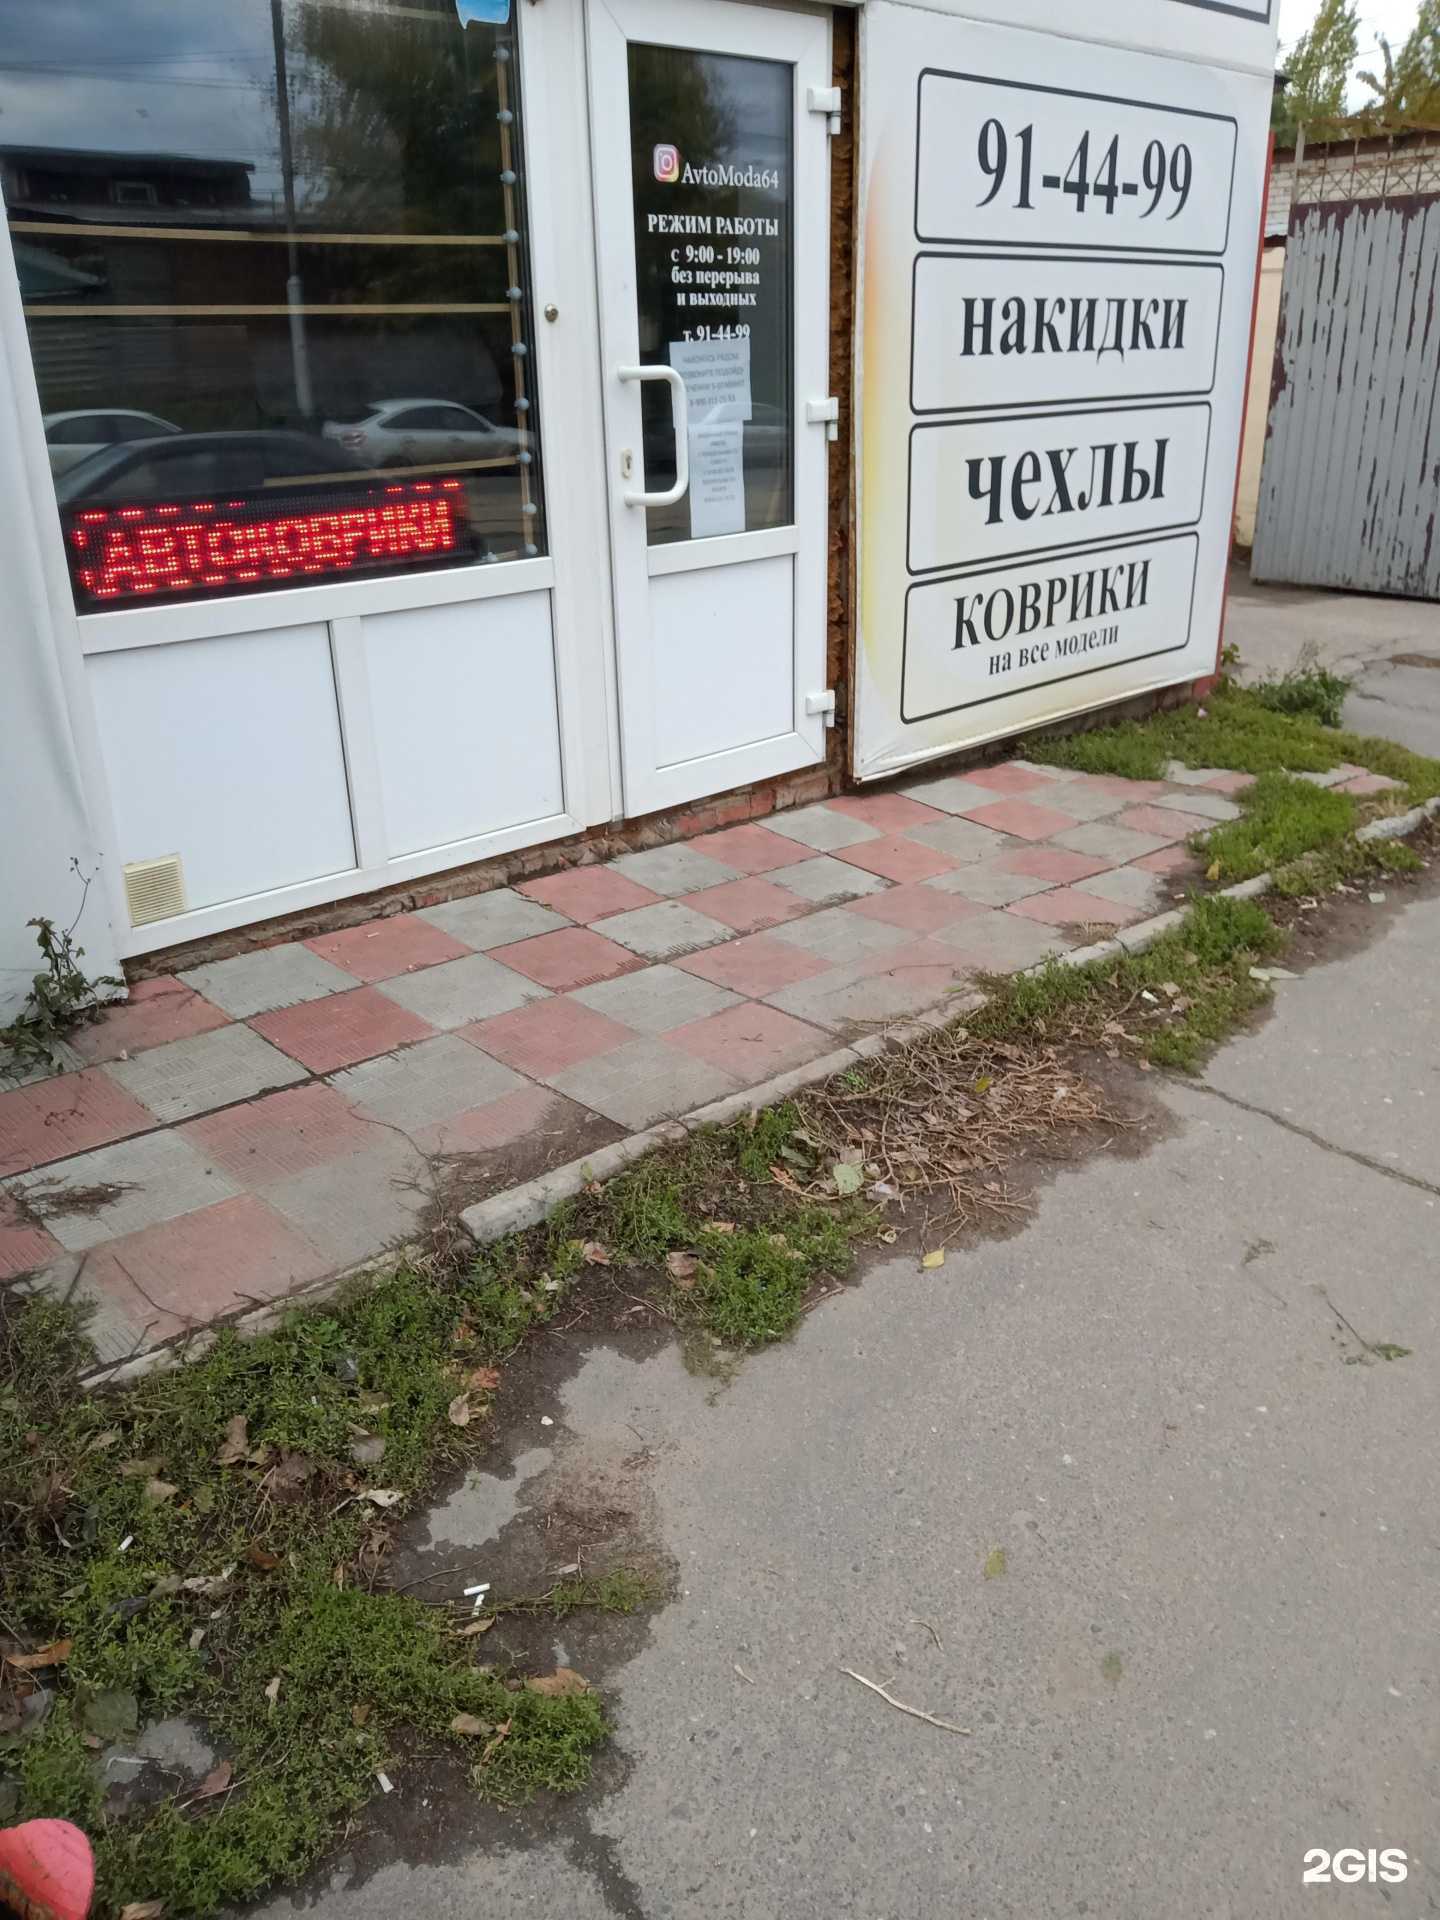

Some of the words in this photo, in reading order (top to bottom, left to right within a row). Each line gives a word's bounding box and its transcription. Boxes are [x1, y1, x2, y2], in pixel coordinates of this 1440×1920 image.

[681, 162, 779, 188] AvtoModa64
[976, 118, 1192, 221] 91-44-99
[647, 214, 711, 234] РЕЖИМ
[716, 216, 778, 236] РАБОТЫ
[671, 249, 679, 262] с
[685, 245, 714, 263] 9:00
[727, 247, 760, 264] 19:00
[671, 266, 693, 284] без
[696, 271, 760, 289] перерыва
[677, 293, 686, 306] и
[689, 292, 757, 307] выходных
[696, 324, 750, 342] 91-44-99
[960, 296, 1188, 365] накидки
[965, 438, 1170, 526] чехлы
[951, 558, 1152, 651] КОВРИКИ
[988, 649, 1012, 676] на
[1018, 640, 1049, 667] все
[1055, 625, 1119, 659] модели
